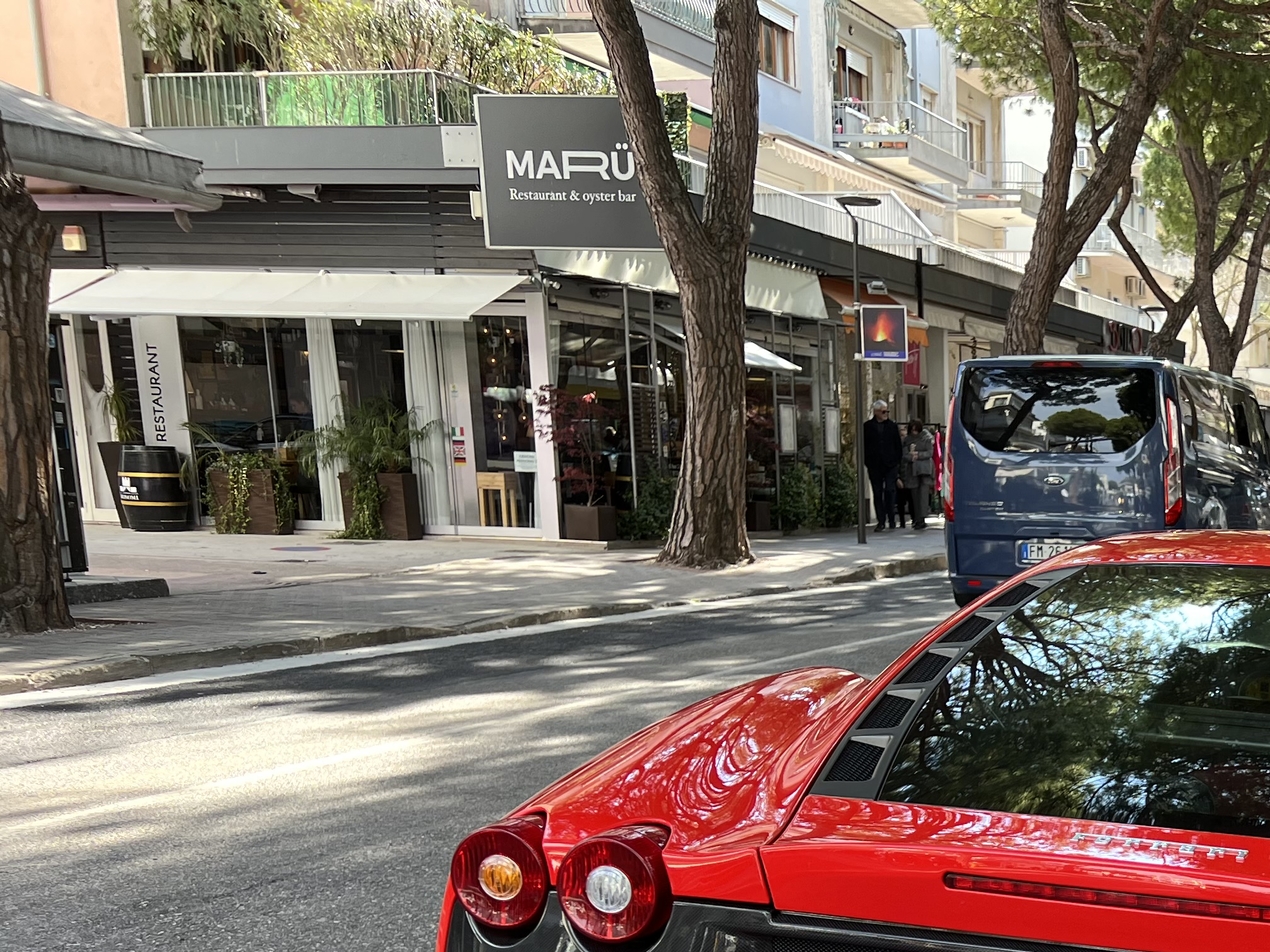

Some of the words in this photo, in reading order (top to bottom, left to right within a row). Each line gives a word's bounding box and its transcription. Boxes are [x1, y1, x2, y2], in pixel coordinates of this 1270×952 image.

[505, 142, 636, 181] MARÜ
[509, 188, 567, 201] Restaurant
[570, 190, 581, 201] &
[583, 191, 616, 205] oyster
[618, 190, 637, 202] bar
[146, 343, 167, 442] RESTAURANT
[1029, 545, 1044, 558] FM
